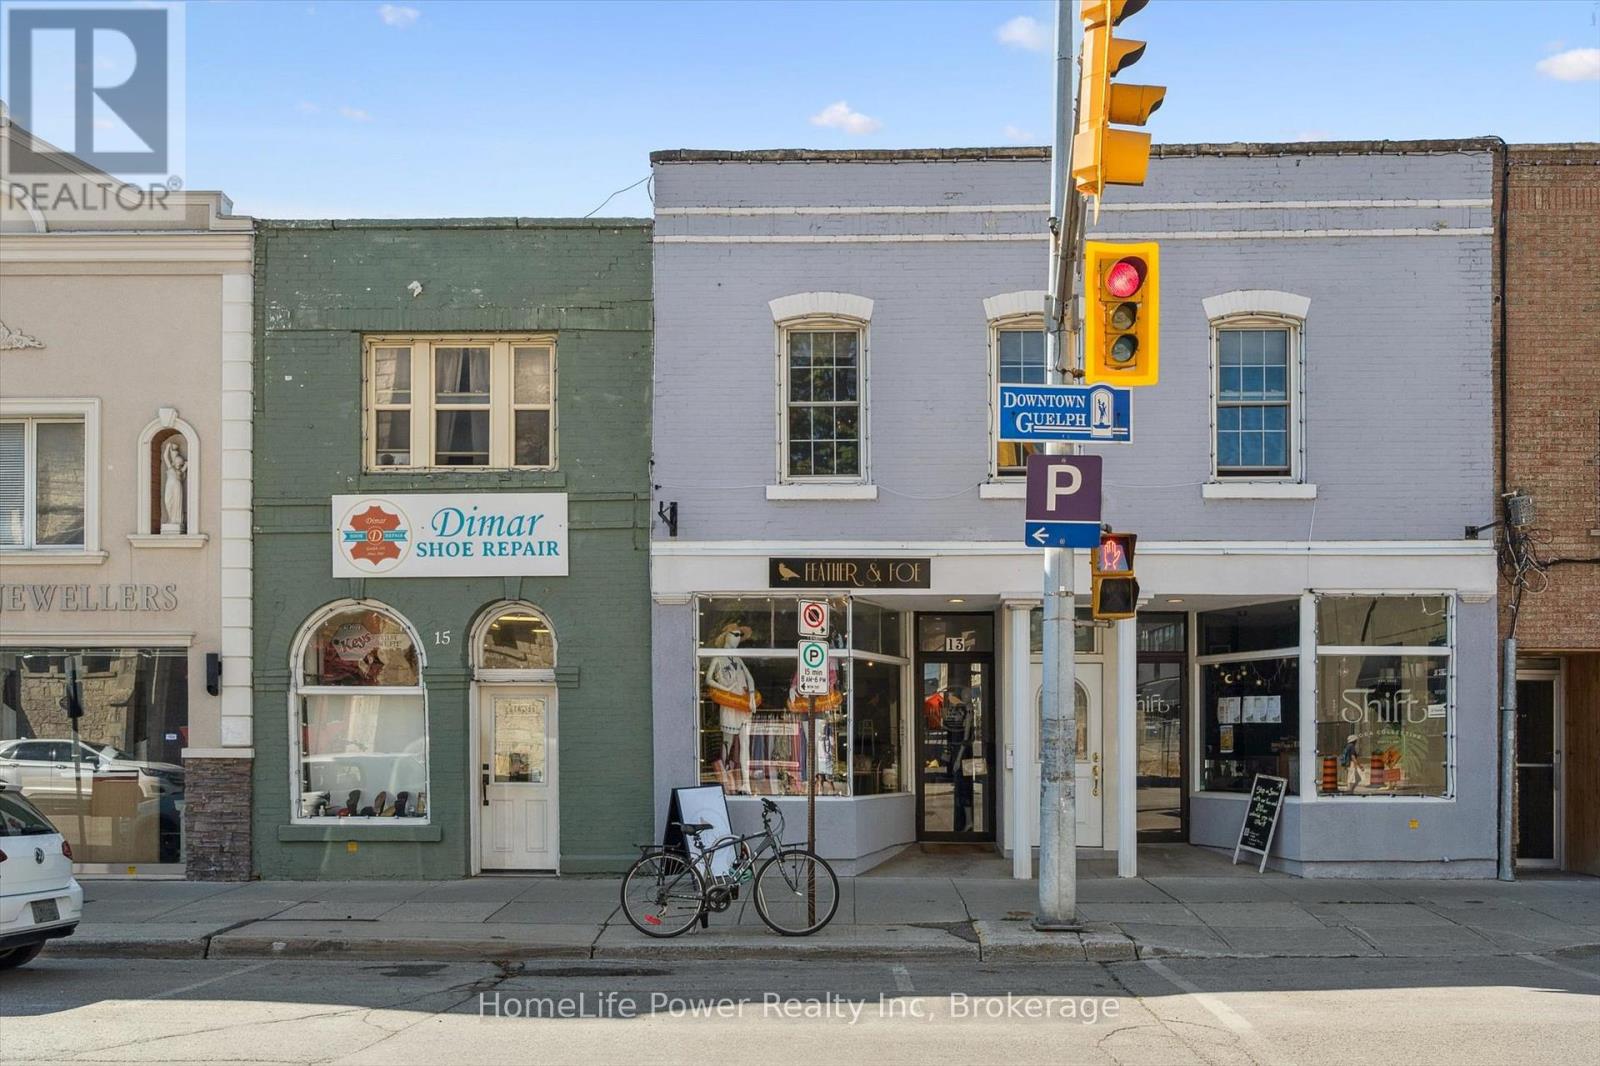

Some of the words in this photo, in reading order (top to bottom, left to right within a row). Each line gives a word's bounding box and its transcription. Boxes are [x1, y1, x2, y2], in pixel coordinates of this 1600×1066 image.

[1003, 391, 1086, 408] DOWNTOWN
[1015, 412, 1087, 433] GUELPH
[1046, 464, 1083, 511] P
[430, 506, 545, 537] Dimar
[416, 541, 474, 558] SHOE
[482, 540, 560, 557] REPAIR
[805, 562, 864, 587] FEATHER
[866, 562, 882, 582] &
[889, 562, 921, 583] FOE
[434, 630, 451, 645] 15
[948, 638, 964, 651] 13
[809, 649, 819, 662] P
[804, 667, 811, 676] 15
[1136, 693, 1170, 713] hift
[1341, 688, 1428, 723] Shift
